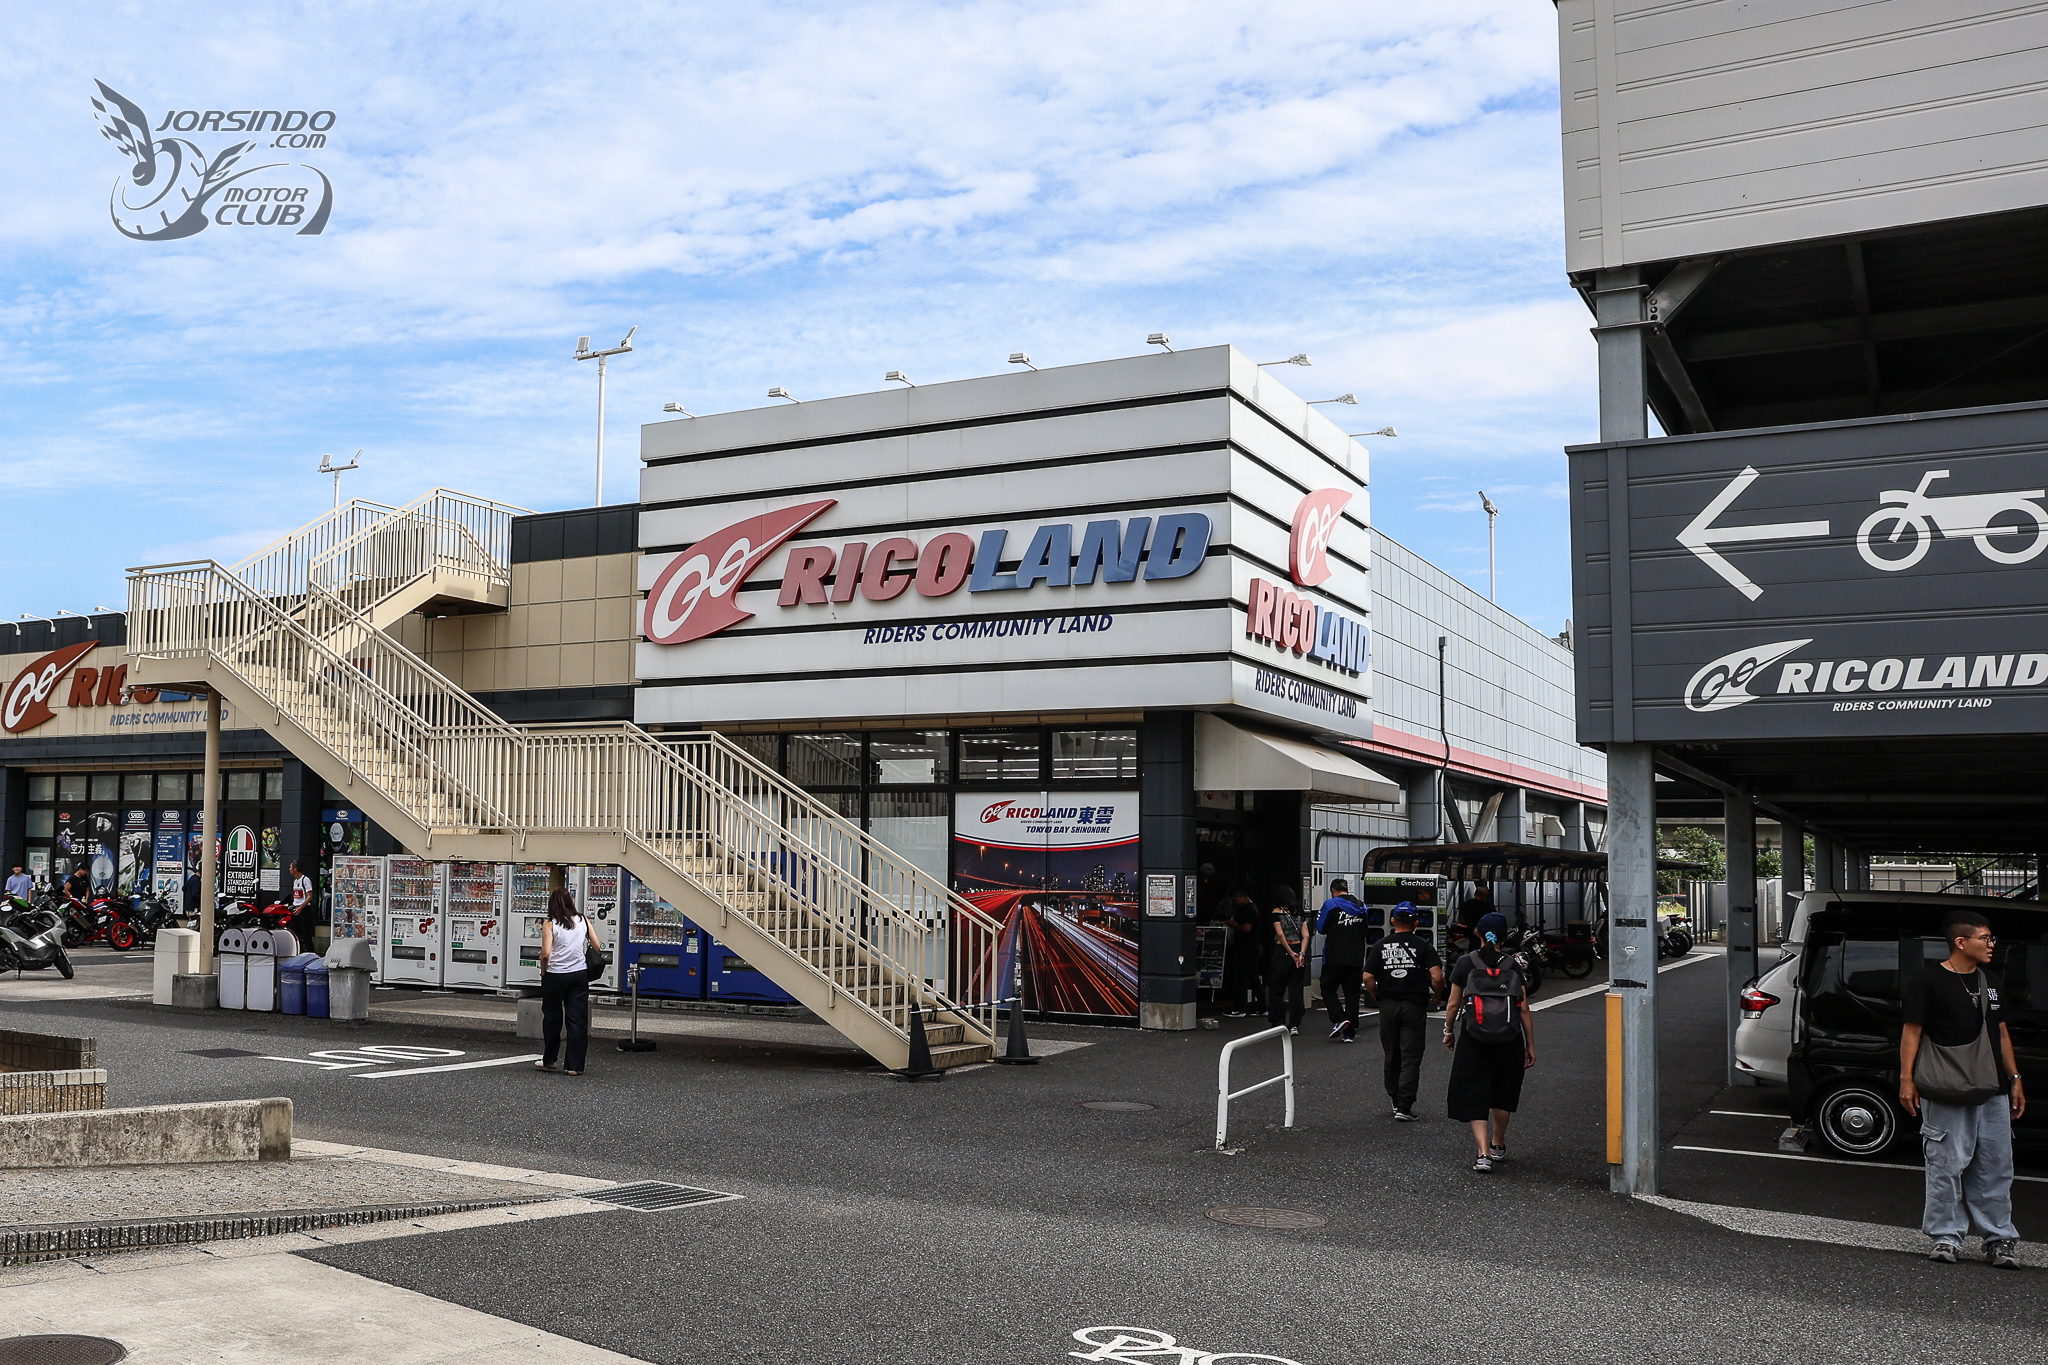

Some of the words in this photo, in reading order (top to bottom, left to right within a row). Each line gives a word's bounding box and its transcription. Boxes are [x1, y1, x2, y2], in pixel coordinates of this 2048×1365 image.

[777, 512, 1213, 607] RICOLAND
[863, 625, 927, 644] RIDERS
[932, 617, 1055, 641] COMMUNITY
[1058, 614, 1113, 634] LAND
[1247, 578, 1371, 674] RICOLAND
[1776, 653, 2048, 694] RICOLAND
[1255, 668, 1286, 699] RIDERS
[1288, 679, 1337, 713] COMMUNITY
[1337, 695, 1357, 719] LAND
[1832, 701, 1874, 712] RIDERS
[1877, 698, 1955, 711] COMMUNITY
[1958, 697, 1993, 709] LAND
[109, 713, 141, 726] RIDERS
[142, 711, 201, 725] COMMUNITY
[203, 709, 229, 722] LD
[1005, 807, 1078, 818] RICOLAND
[1077, 806, 1115, 824] 東雲
[231, 851, 252, 866] agv
[227, 871, 254, 880] EXTREME
